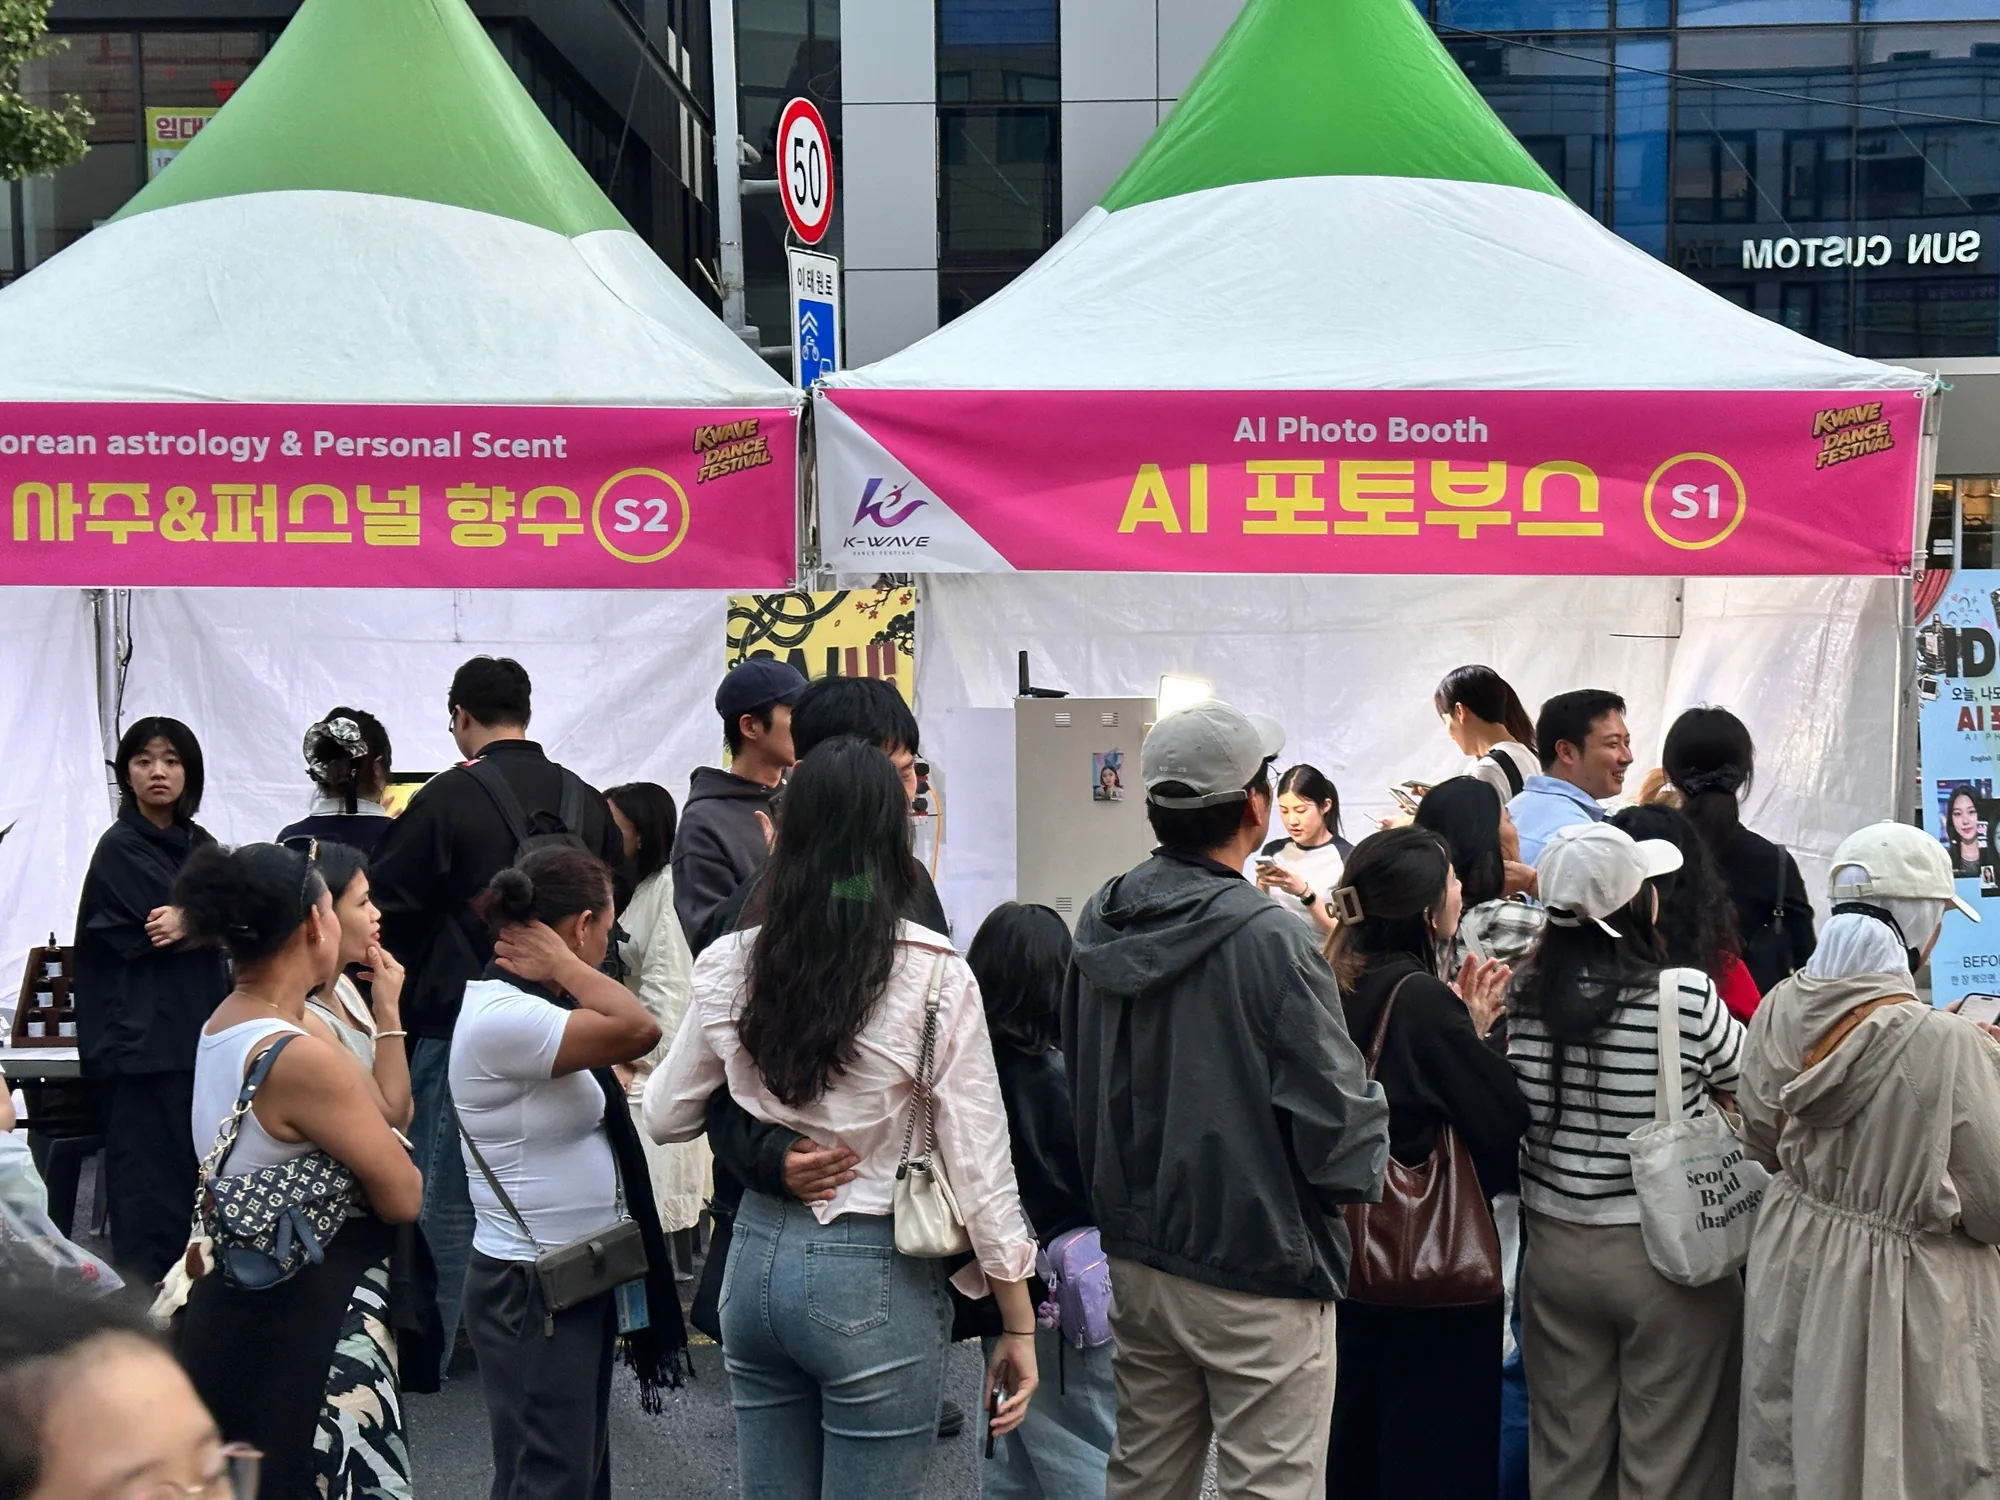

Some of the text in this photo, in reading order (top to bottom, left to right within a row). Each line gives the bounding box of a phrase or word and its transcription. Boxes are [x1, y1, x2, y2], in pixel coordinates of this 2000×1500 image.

[794, 137, 821, 208] 50
[797, 267, 833, 296] 이태원로
[107, 428, 271, 463] astrology
[280, 430, 303, 456] &
[314, 430, 461, 458] Personal
[472, 431, 567, 458] Scent
[1233, 415, 1488, 443] AI Photo Booth
[1823, 420, 1890, 451] DANCE
[697, 450, 773, 484] FESTIVAL
[704, 435, 767, 465] DANCE
[1816, 435, 1895, 470] FESTIVAL
[12, 482, 585, 548] 사주&퍼스널 향수
[612, 498, 670, 533] S2
[1118, 459, 1604, 540] AI 포토부스
[1670, 483, 1720, 519] S1
[843, 536, 930, 548] K-WAVE
[1944, 627, 2000, 678] ID
[1951, 687, 1979, 702] 오늘,
[1956, 706, 1985, 732] AI
[1963, 955, 2000, 969] BEFO
